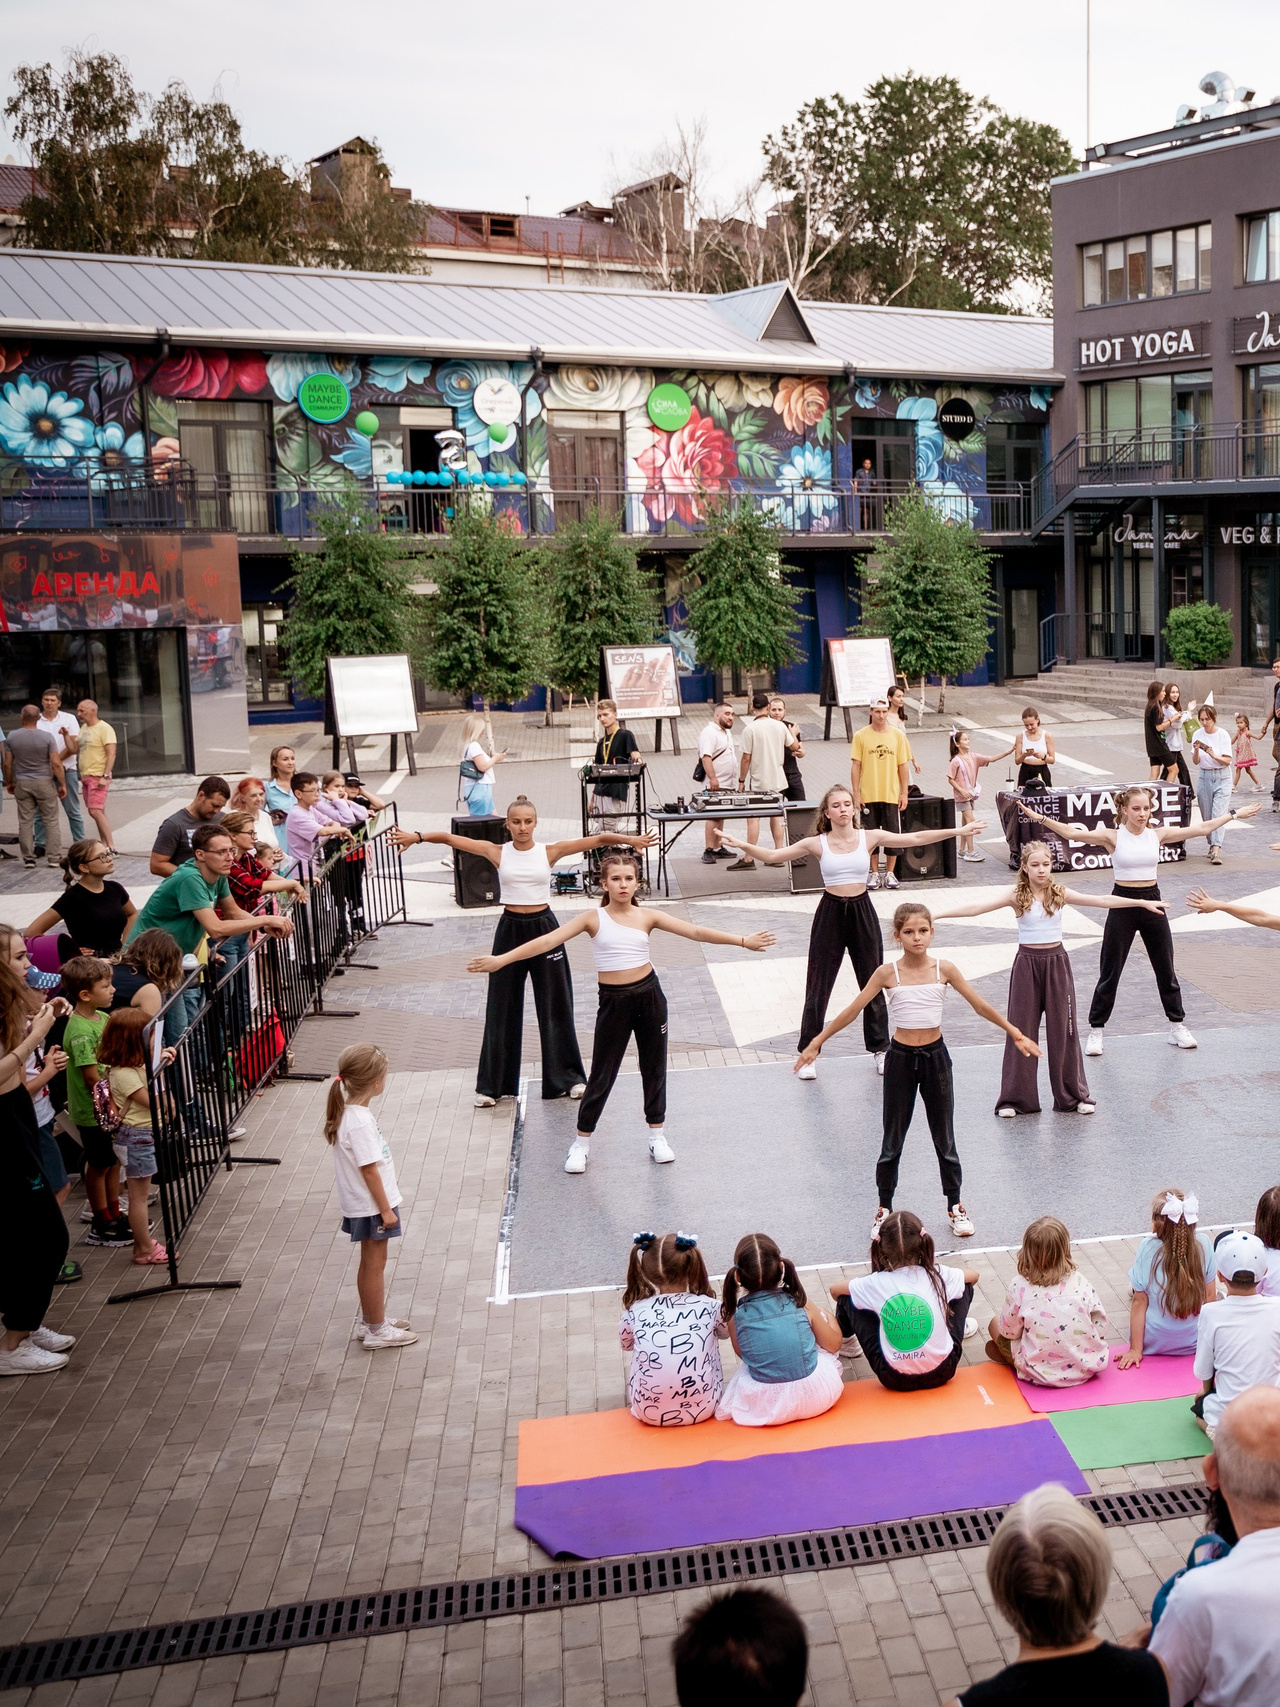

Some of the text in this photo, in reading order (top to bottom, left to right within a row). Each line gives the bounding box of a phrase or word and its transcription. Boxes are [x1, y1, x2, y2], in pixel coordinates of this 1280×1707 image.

[1081, 328, 1195, 365] HOT YOGA
[307, 383, 342, 394] MAYBE
[308, 394, 342, 405] DANCE
[309, 404, 343, 412] COMMUNITY
[1114, 514, 1199, 542] Jamna
[1220, 526, 1255, 544] VEG
[1259, 526, 1273, 544] &
[32, 571, 161, 598] АРЕНДА
[614, 653, 643, 664] SENS
[1067, 786, 1181, 818] MABE
[1018, 804, 1060, 815] DNCE
[1071, 845, 1181, 871] Comity
[884, 1305, 926, 1319] MAYBE
[886, 1318, 927, 1332] DANCE
[888, 1332, 927, 1341] COMMUNITY
[892, 1351, 926, 1361] SAMIRA
